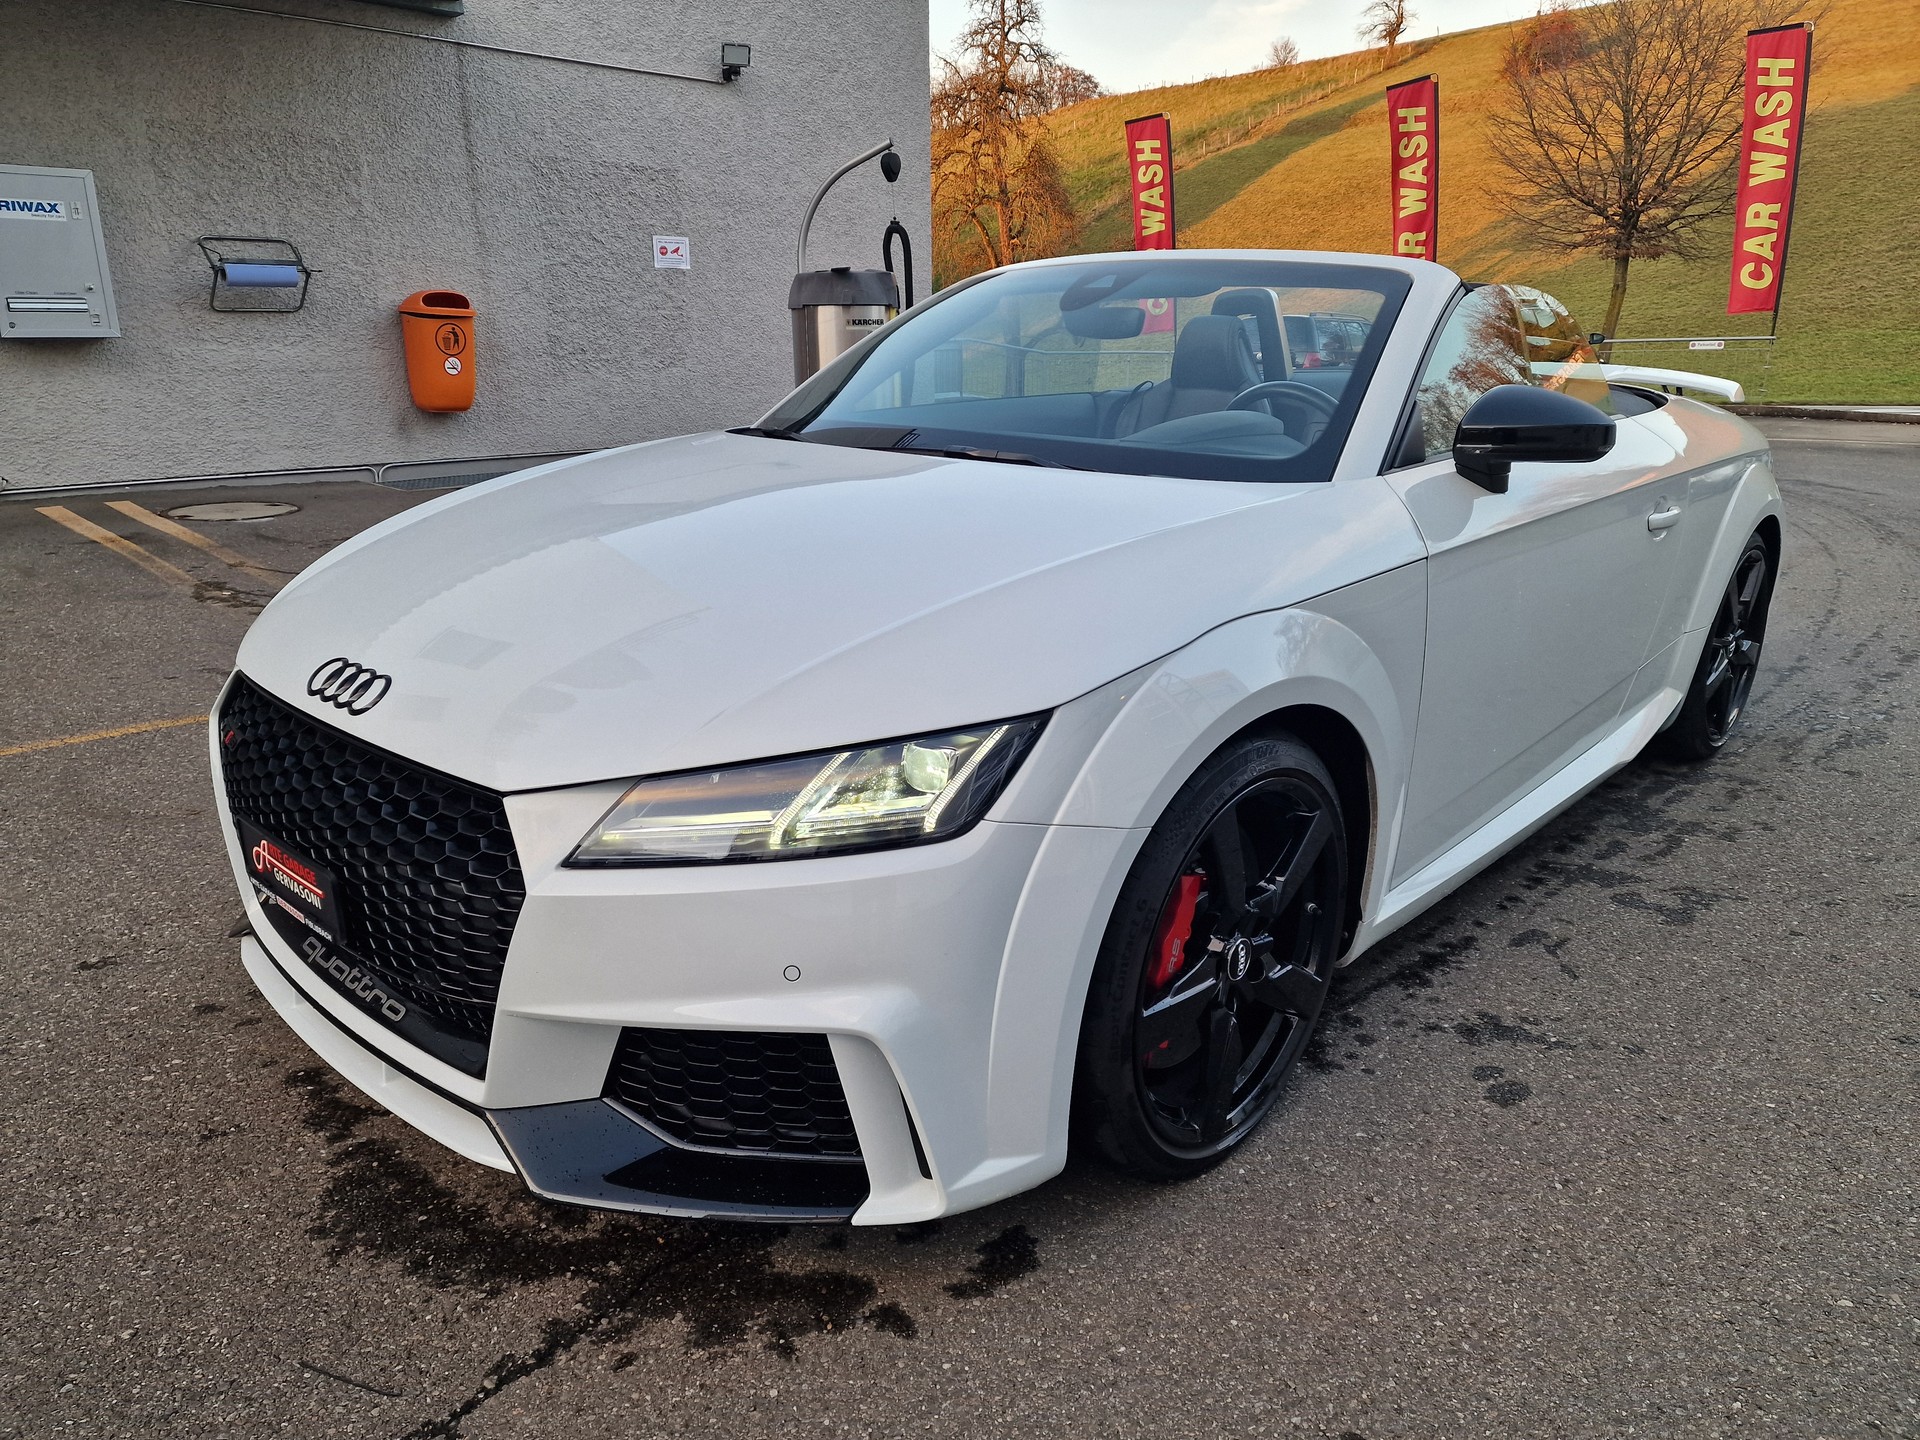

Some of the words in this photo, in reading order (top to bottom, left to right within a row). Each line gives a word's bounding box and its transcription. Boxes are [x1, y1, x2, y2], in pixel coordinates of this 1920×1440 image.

[1398, 106, 1429, 219] WASH
[1749, 58, 1795, 187] WASH
[0, 200, 61, 214] RIWAX
[1135, 139, 1166, 237] WASH
[1740, 202, 1782, 289] CAR
[273, 867, 322, 910] GERVASONI
[283, 853, 317, 886] GARAGE
[302, 936, 407, 1022] quattro
[1167, 938, 1182, 973] RS
